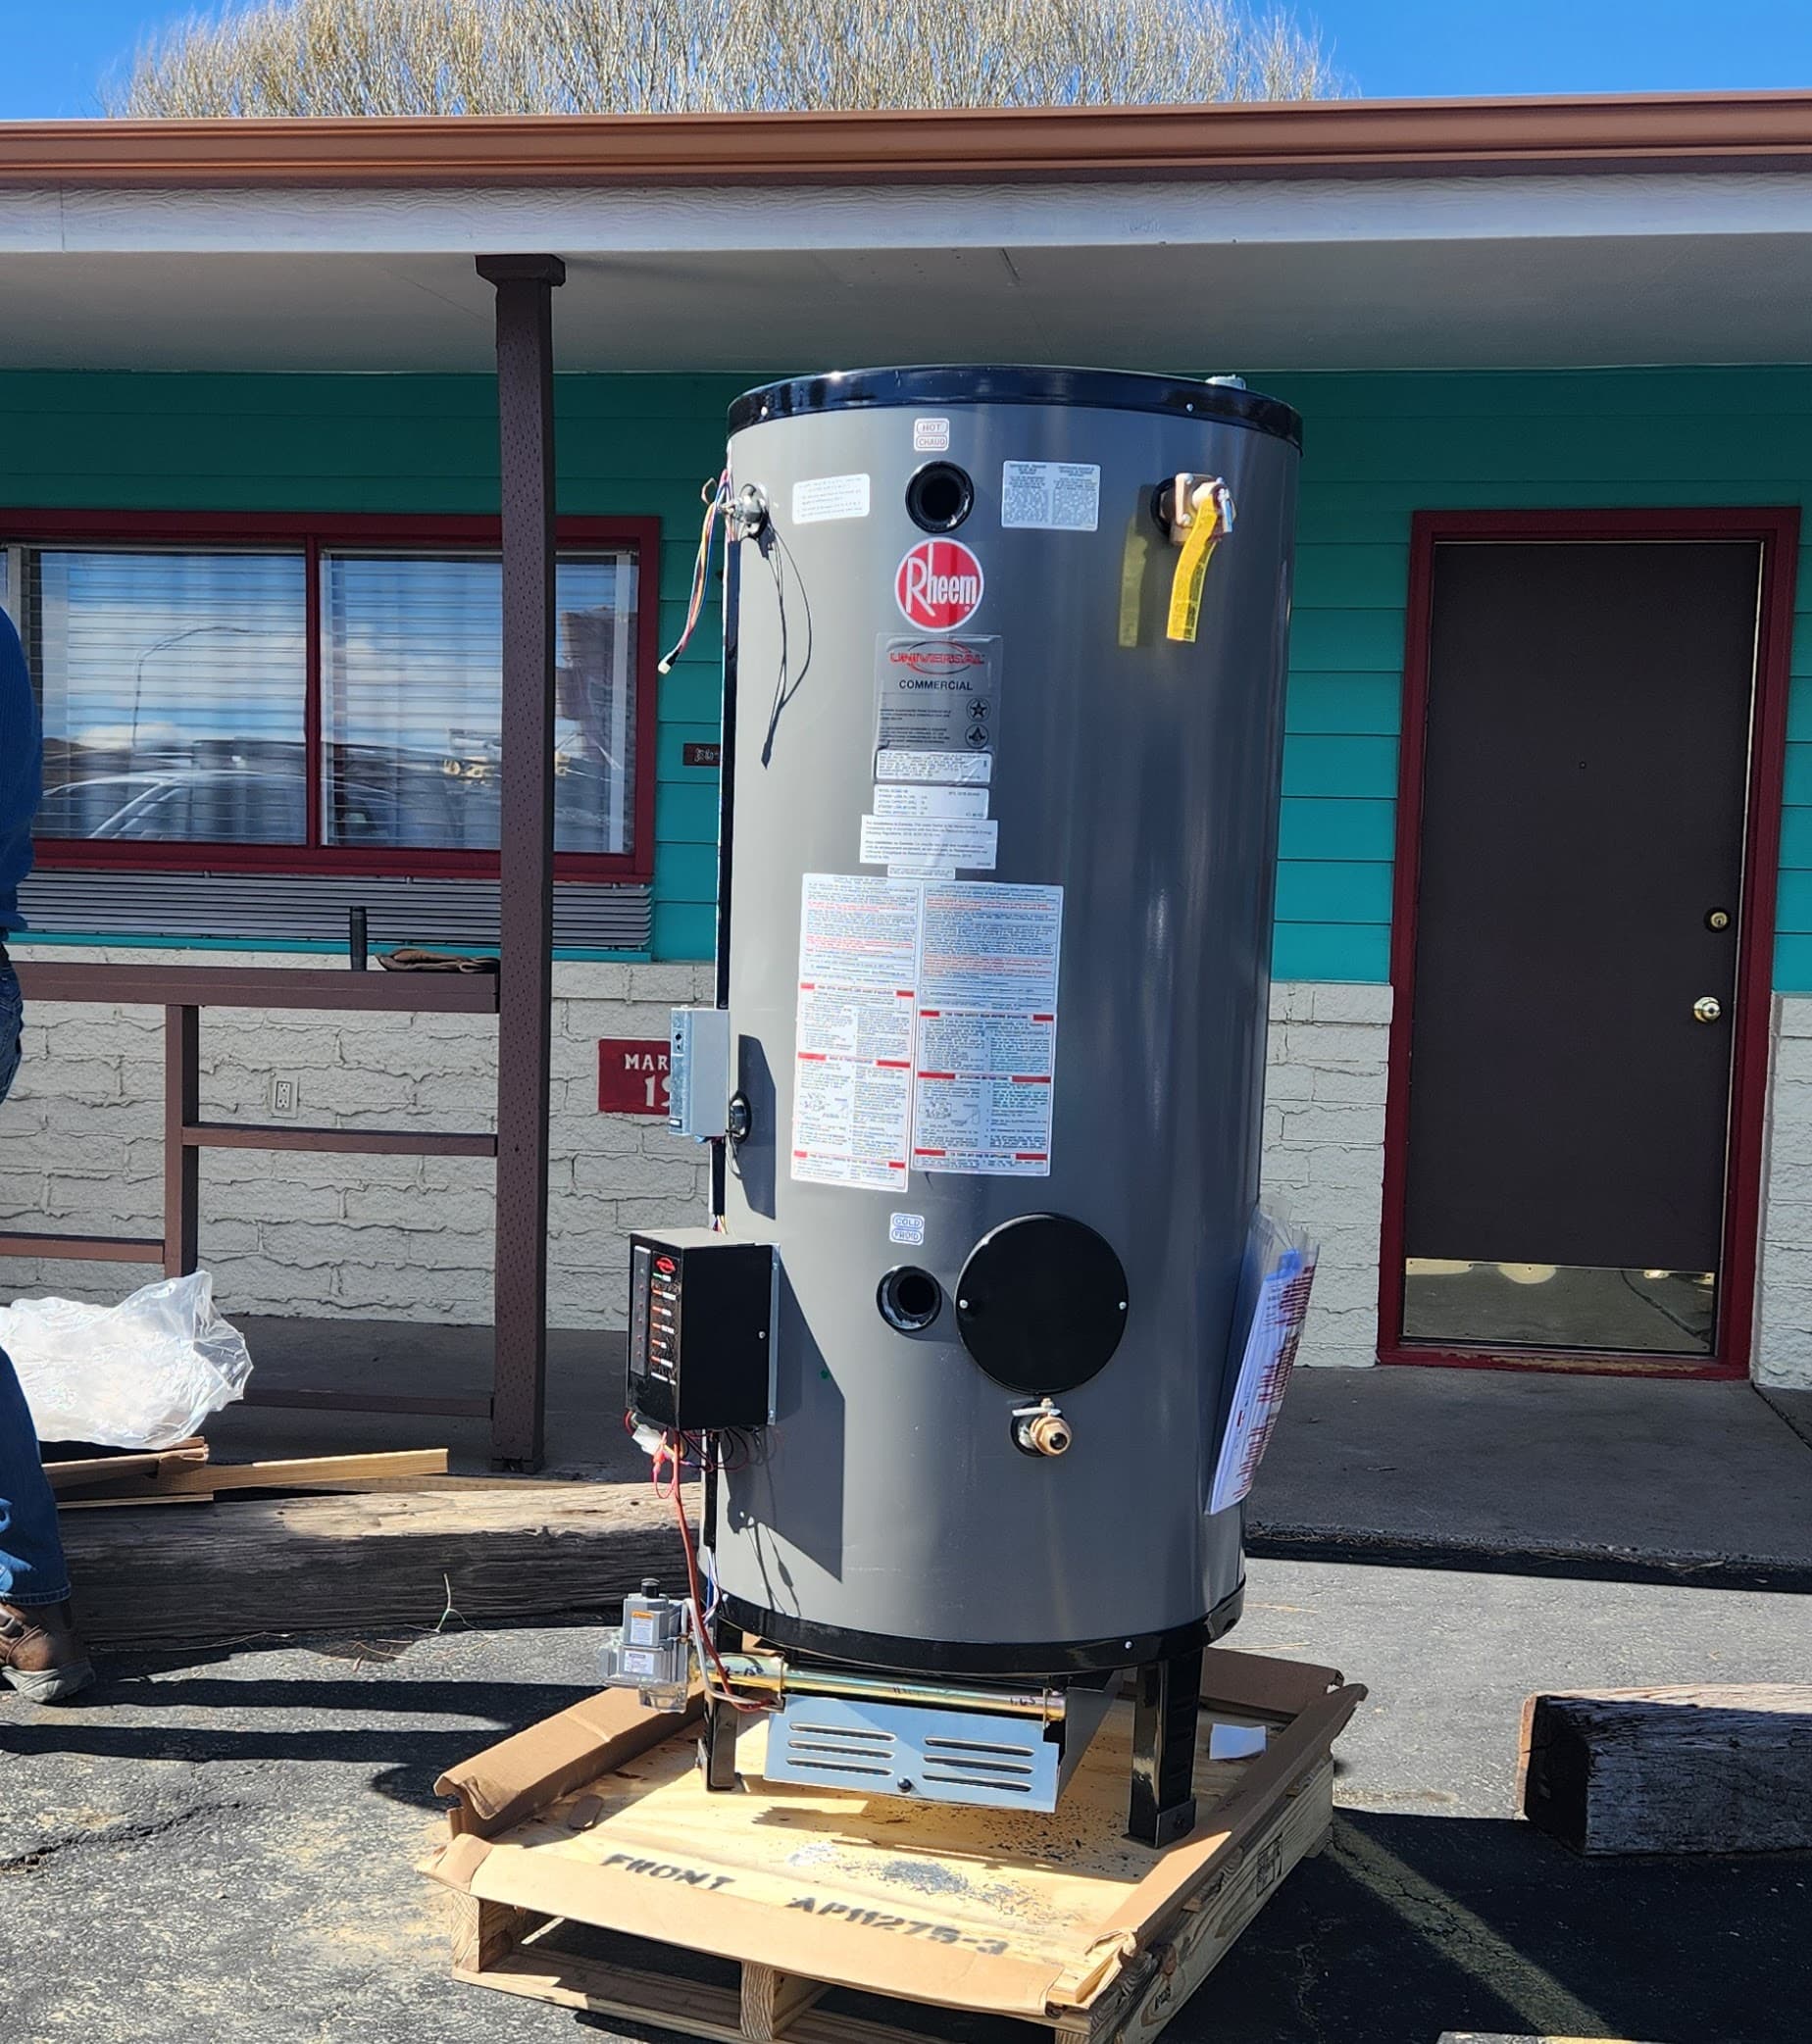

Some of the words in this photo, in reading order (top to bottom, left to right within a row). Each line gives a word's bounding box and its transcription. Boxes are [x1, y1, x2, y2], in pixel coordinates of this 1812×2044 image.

[922, 423, 942, 432] HOT
[919, 437, 946, 447] CHAUD
[905, 542, 978, 618] Rheem
[889, 652, 985, 666] UNIVERSAL
[899, 679, 974, 691] COMMERCIAL
[895, 1218, 921, 1226] COLD
[599, 1853, 736, 1891] FRONT
